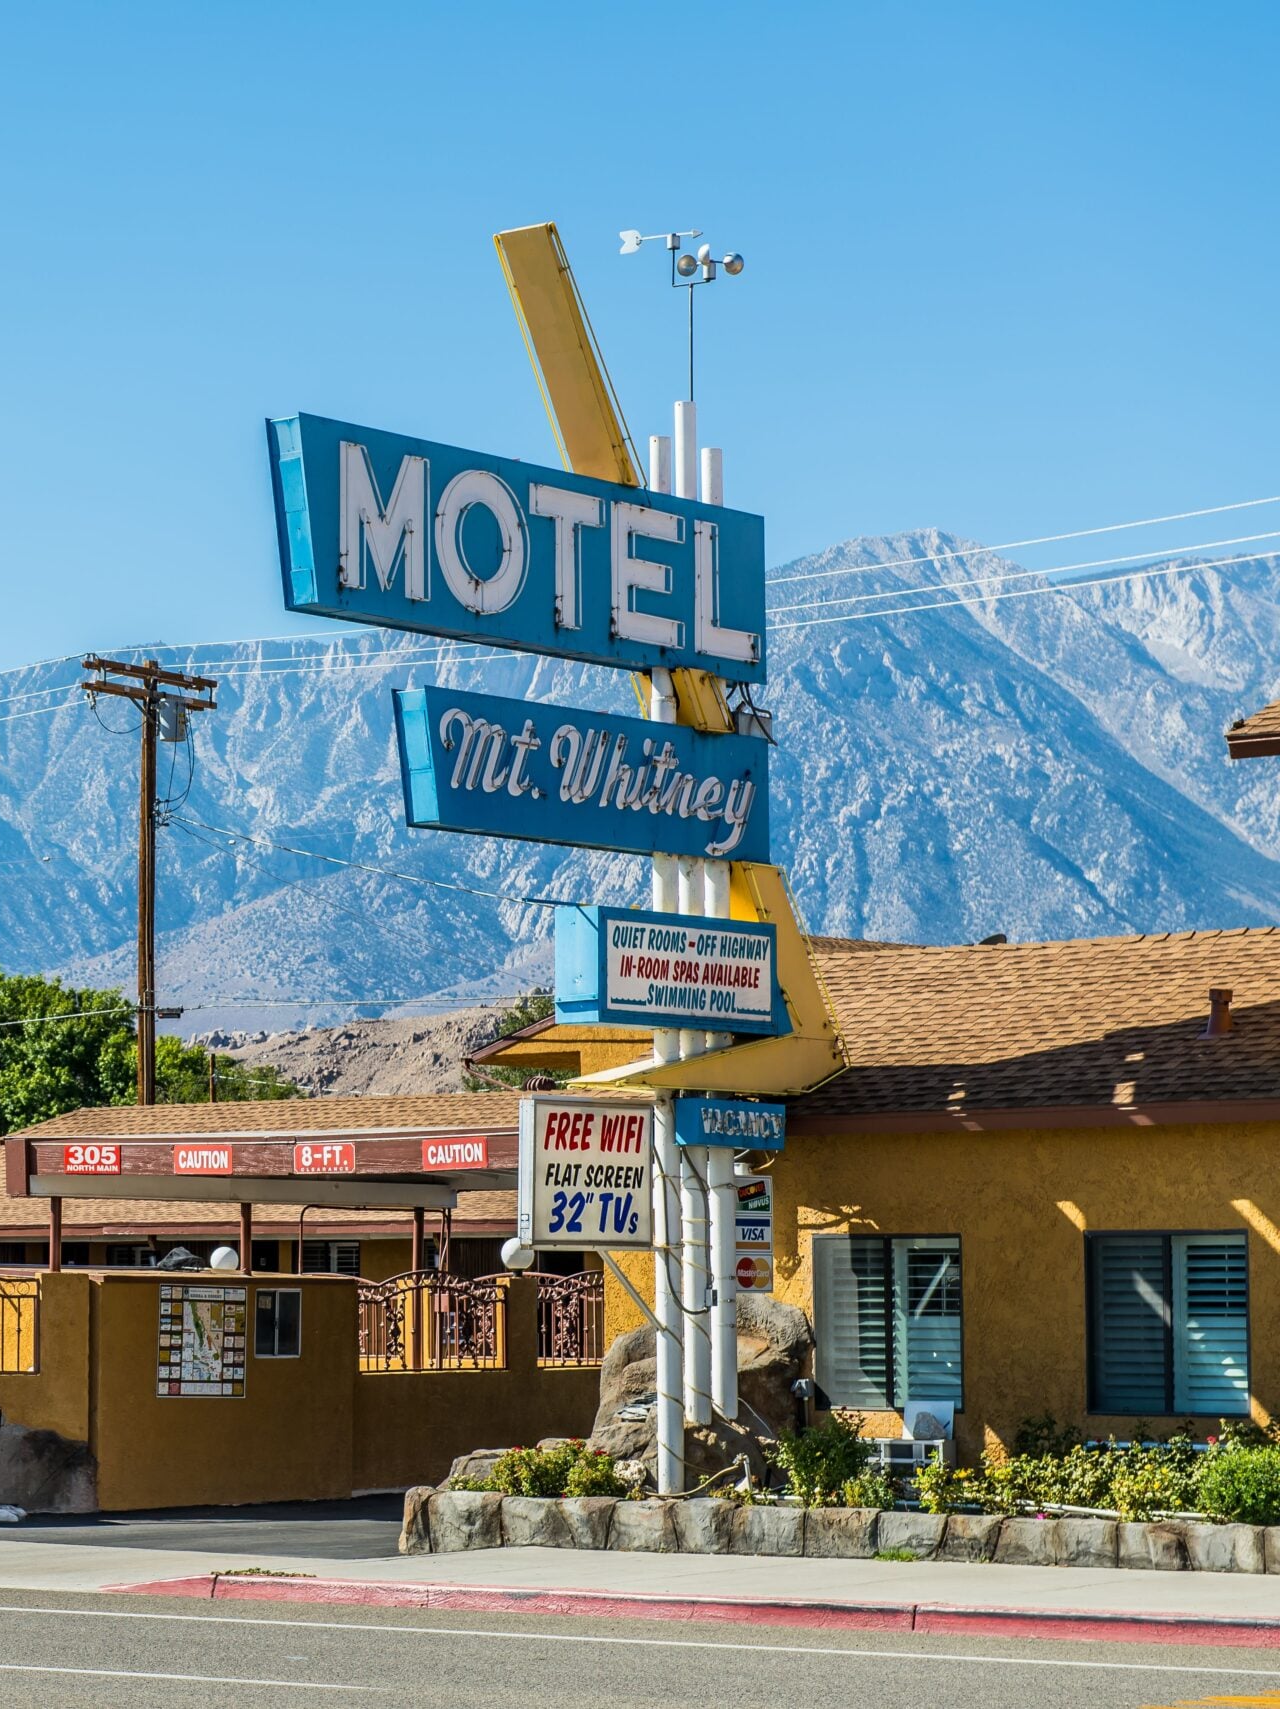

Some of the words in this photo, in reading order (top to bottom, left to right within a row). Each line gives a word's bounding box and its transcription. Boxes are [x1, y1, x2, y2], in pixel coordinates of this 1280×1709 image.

[339, 440, 762, 663] MOTEL
[439, 708, 546, 799] Mt.
[548, 724, 755, 856] Whitney
[612, 925, 646, 949] QUIET
[720, 935, 770, 961] HIGHWAY
[620, 955, 670, 980] IN-ROOM
[672, 960, 700, 984] SPAS
[701, 963, 761, 989] AVAILABLE
[646, 983, 707, 1010] SWIMMING
[709, 989, 738, 1014] POOL
[544, 1112, 595, 1151] FREE
[600, 1114, 645, 1154] WIFI
[701, 1107, 783, 1139] VACANCY
[68, 1146, 116, 1165] 305
[178, 1151, 229, 1169] CAUTION
[301, 1145, 348, 1166] 8-FT.
[427, 1143, 483, 1165] CAUTION
[66, 1164, 95, 1172] NORTH
[545, 1163, 582, 1187] FLAT
[584, 1164, 645, 1189] SCREEN
[549, 1191, 595, 1233] 32"
[598, 1192, 639, 1235] TVs
[748, 1197, 769, 1209] NOVUS
[741, 1228, 764, 1241] VISA
[737, 1269, 770, 1277] MasterCard
